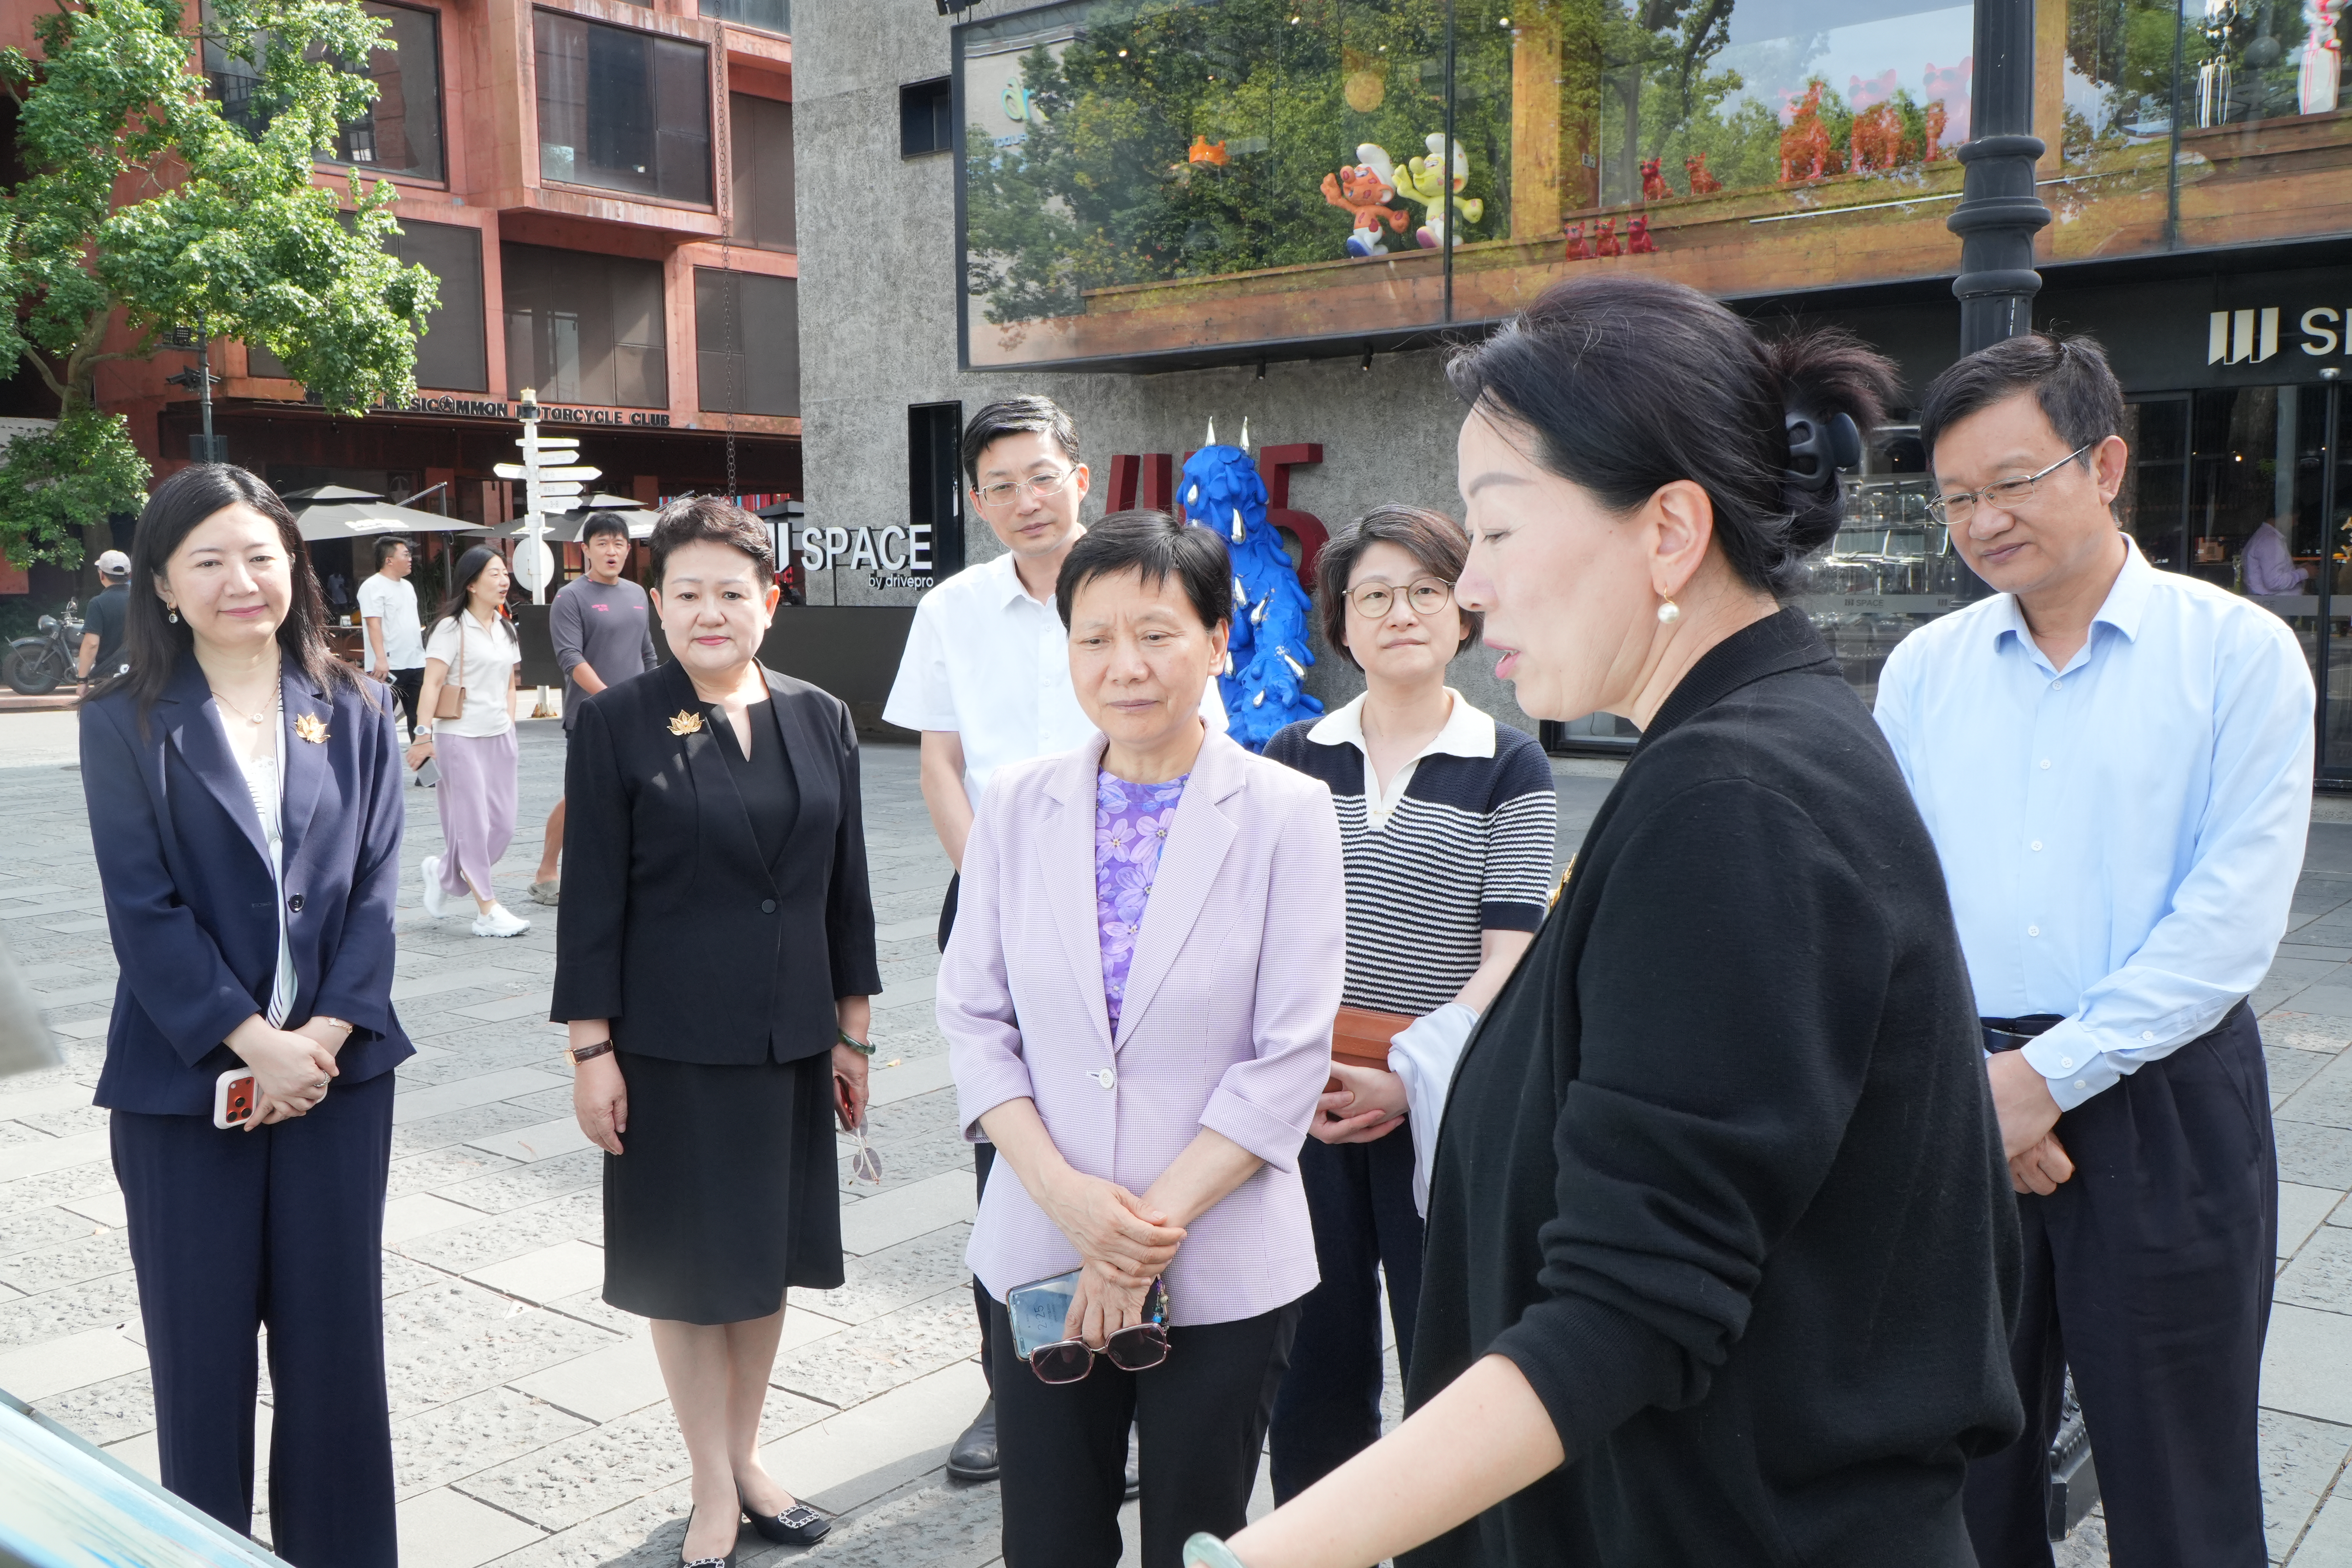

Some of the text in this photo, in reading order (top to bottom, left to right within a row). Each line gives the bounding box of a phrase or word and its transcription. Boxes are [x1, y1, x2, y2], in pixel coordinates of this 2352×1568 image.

[515, 405, 623, 424] TORCYCLE
[630, 413, 670, 427] CLUB
[801, 524, 933, 571] SPACE
[868, 574, 934, 591] by drivepro
[1034, 1306, 1047, 1331] 2:25
